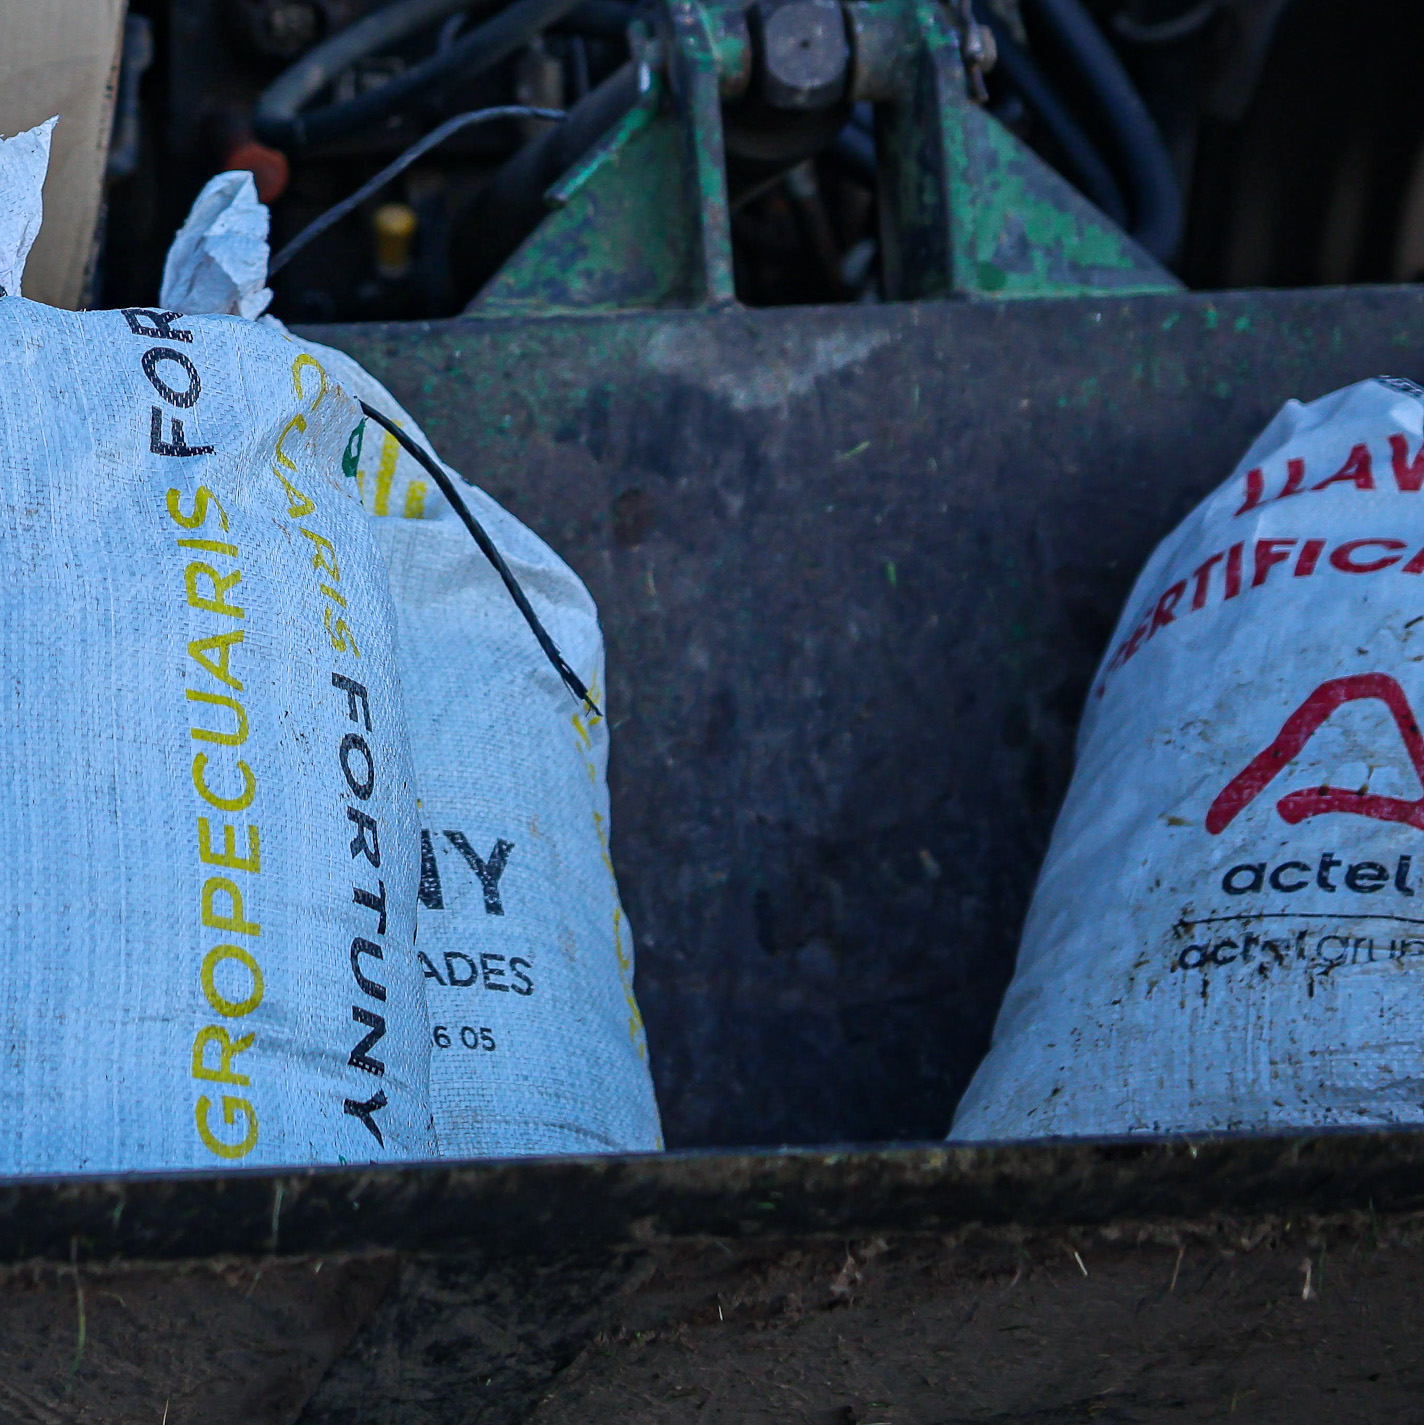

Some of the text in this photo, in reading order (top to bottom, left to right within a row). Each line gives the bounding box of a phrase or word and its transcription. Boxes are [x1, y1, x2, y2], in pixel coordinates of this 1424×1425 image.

[1222, 851, 1416, 897] actel
[330, 671, 389, 1152] FORTUNY
[460, 1026, 497, 1052] 05
